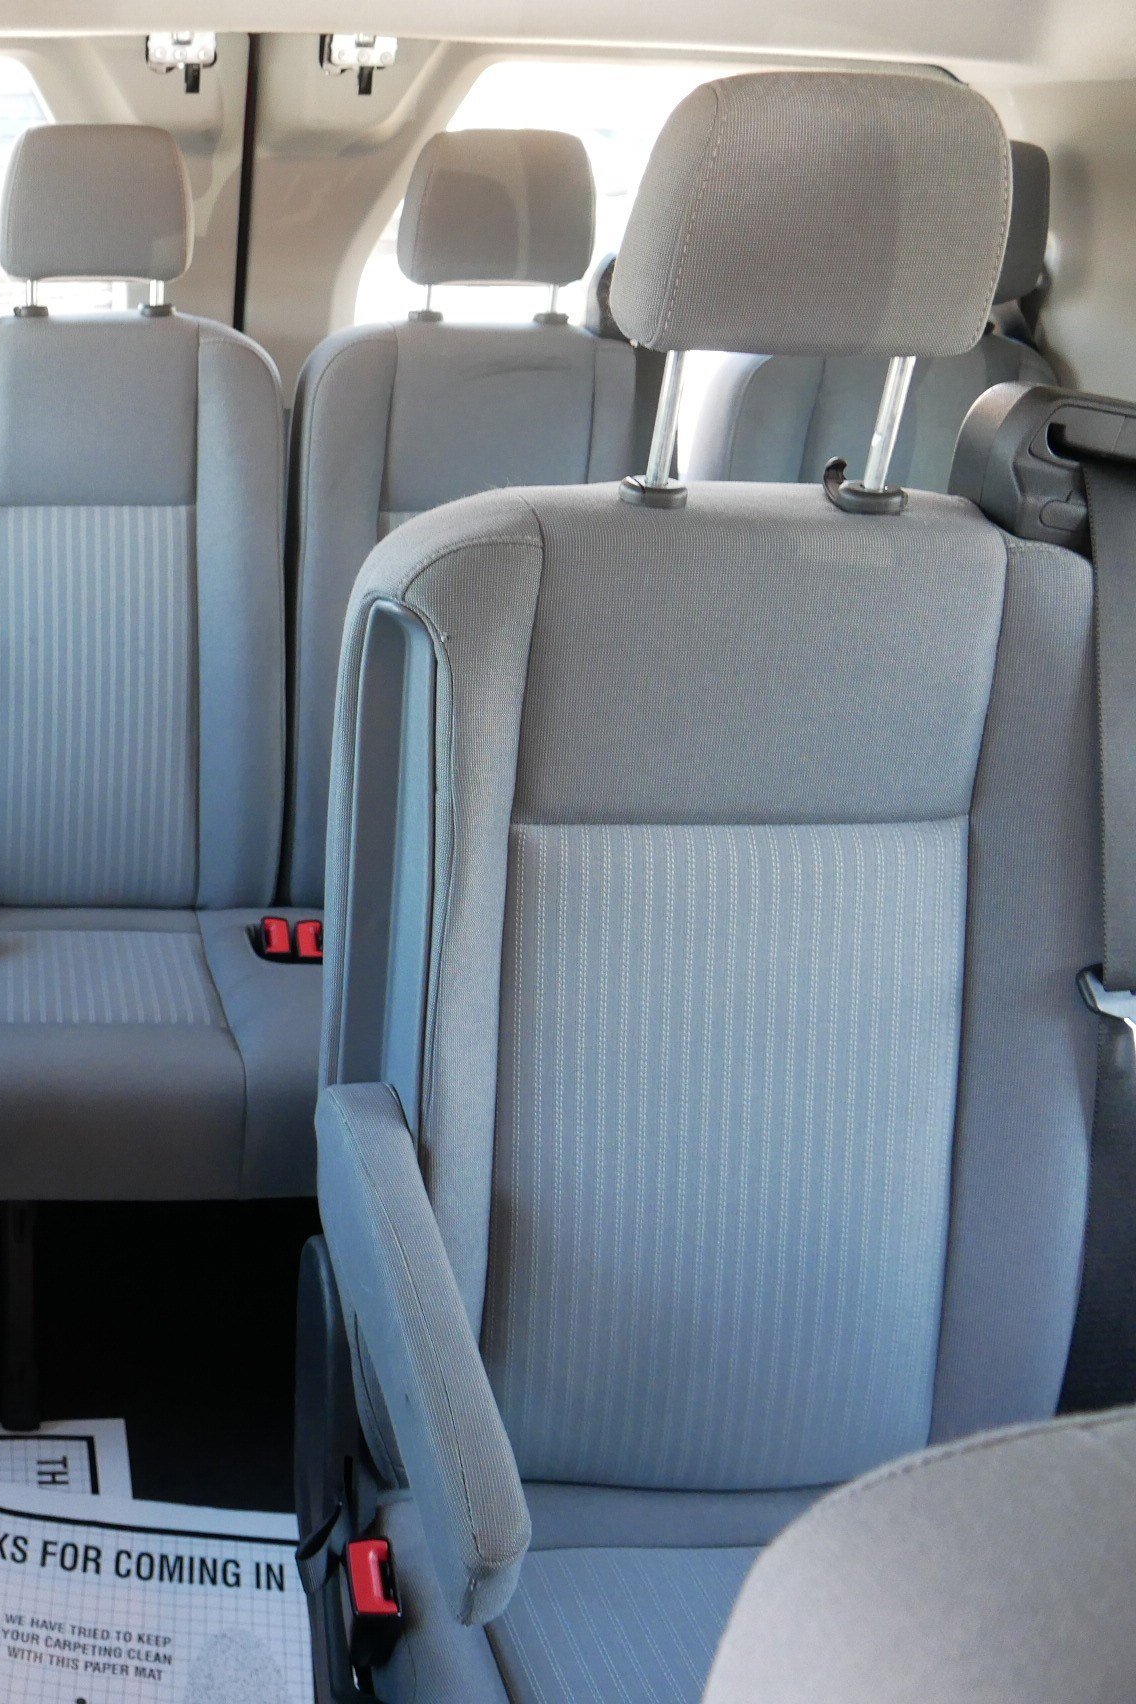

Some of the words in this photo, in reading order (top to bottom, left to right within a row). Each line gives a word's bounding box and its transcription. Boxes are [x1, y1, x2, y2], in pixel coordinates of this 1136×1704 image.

[40, 1540, 102, 1574] FOR
[115, 1549, 241, 1587] COMING
[255, 1562, 285, 1592] IN
[1, 1628, 40, 1645] YOUR
[45, 1635, 122, 1658] CARPETING
[127, 1648, 172, 1665] CLEAN
[5, 1613, 25, 1626] WE
[30, 1617, 64, 1634] HAVE
[70, 1625, 110, 1641] TRIED
[115, 1630, 132, 1643] TO
[137, 1632, 172, 1648] KEEP
[7, 1645, 44, 1664] WITH
[49, 1653, 79, 1671] THIS
[84, 1660, 130, 1677] PAPER
[134, 1666, 163, 1681] MAT
